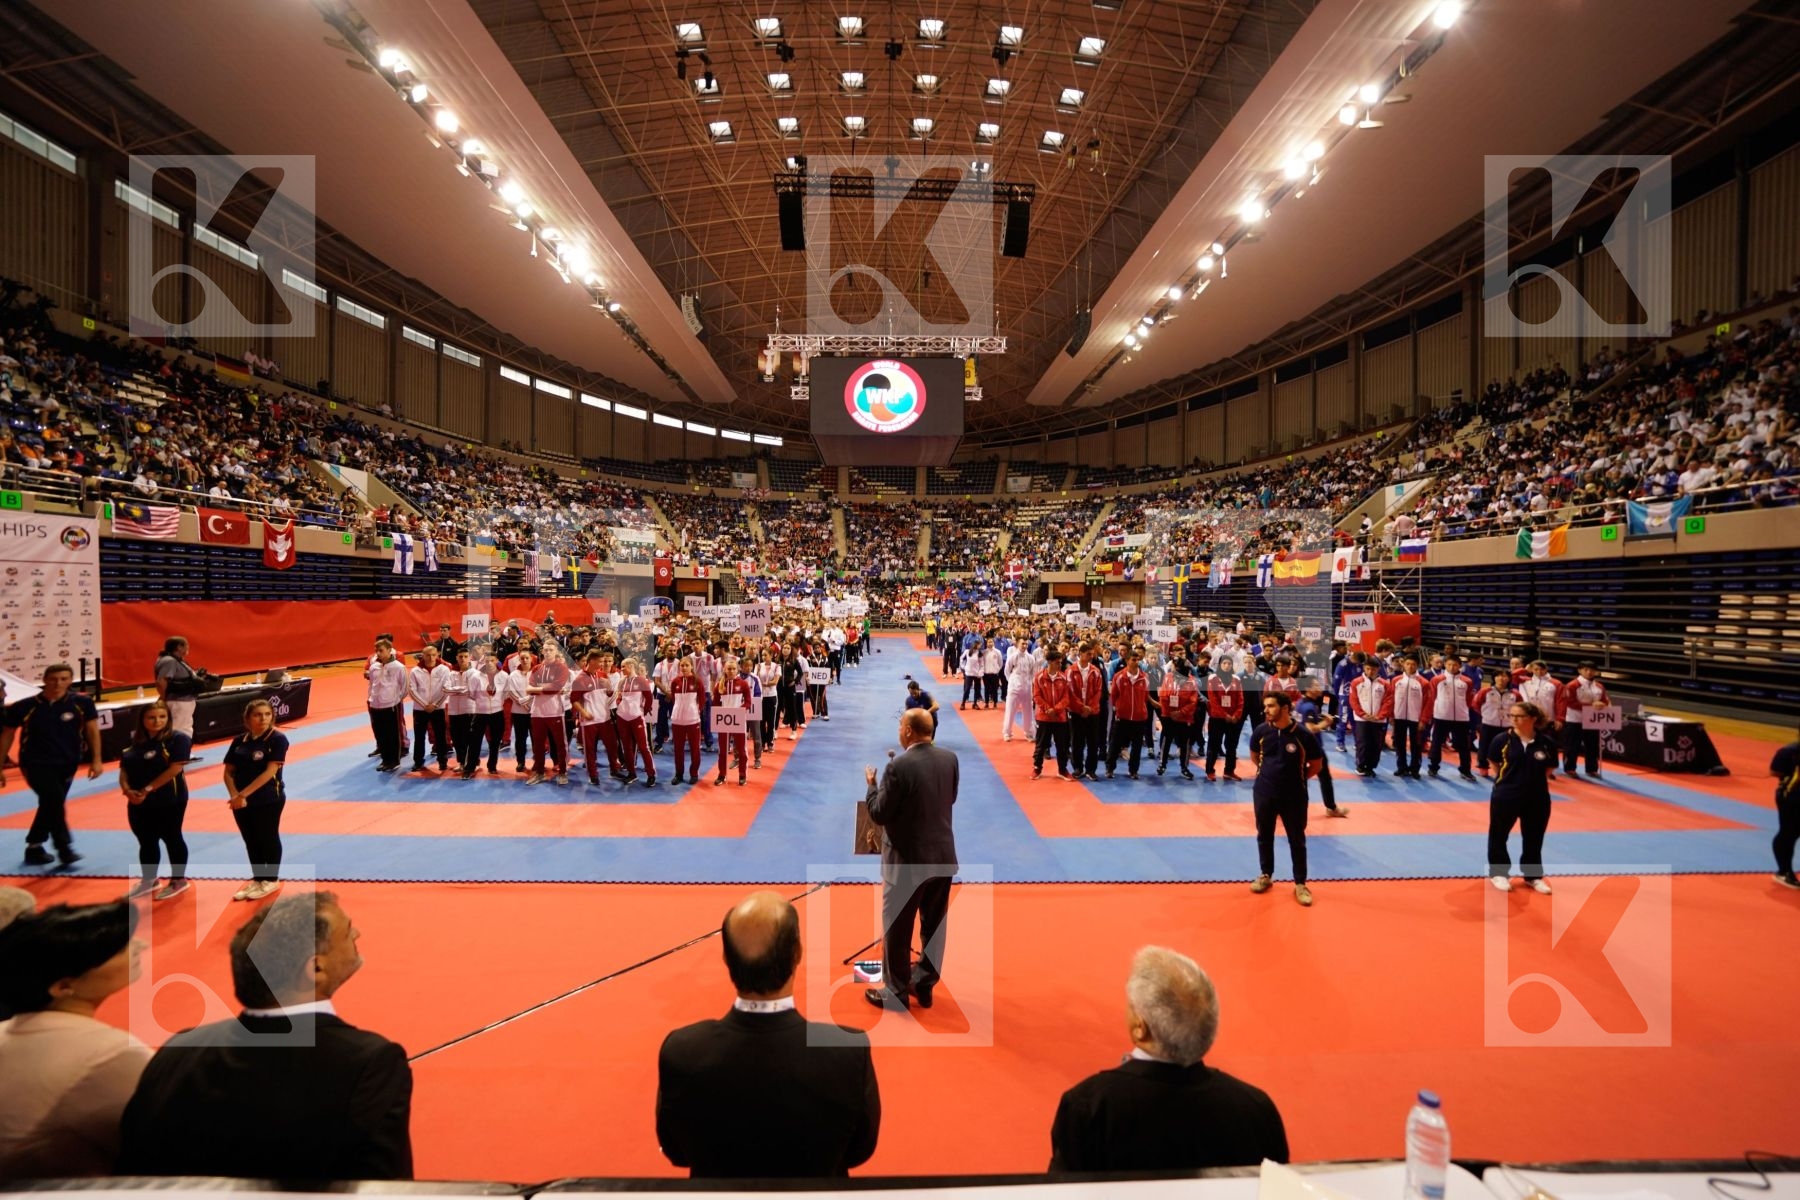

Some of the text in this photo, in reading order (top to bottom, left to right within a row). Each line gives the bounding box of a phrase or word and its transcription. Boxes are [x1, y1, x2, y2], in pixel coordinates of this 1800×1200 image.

[7, 494, 17, 505] B
[0, 522, 48, 538] HIPS
[1605, 528, 1613, 537] P
[643, 608, 656, 616] MLT
[744, 609, 766, 620] PAR
[466, 620, 484, 628] PAN
[595, 616, 610, 624] MDA
[1136, 618, 1153, 626] HKG
[1351, 618, 1369, 628] INA
[1158, 630, 1171, 638] ISL
[1338, 630, 1357, 639] GUA
[811, 672, 828, 680] NED
[100, 713, 108, 725] 1
[716, 714, 740, 726] POL
[1589, 712, 1615, 724] JPN
[1650, 725, 1658, 737] 2
